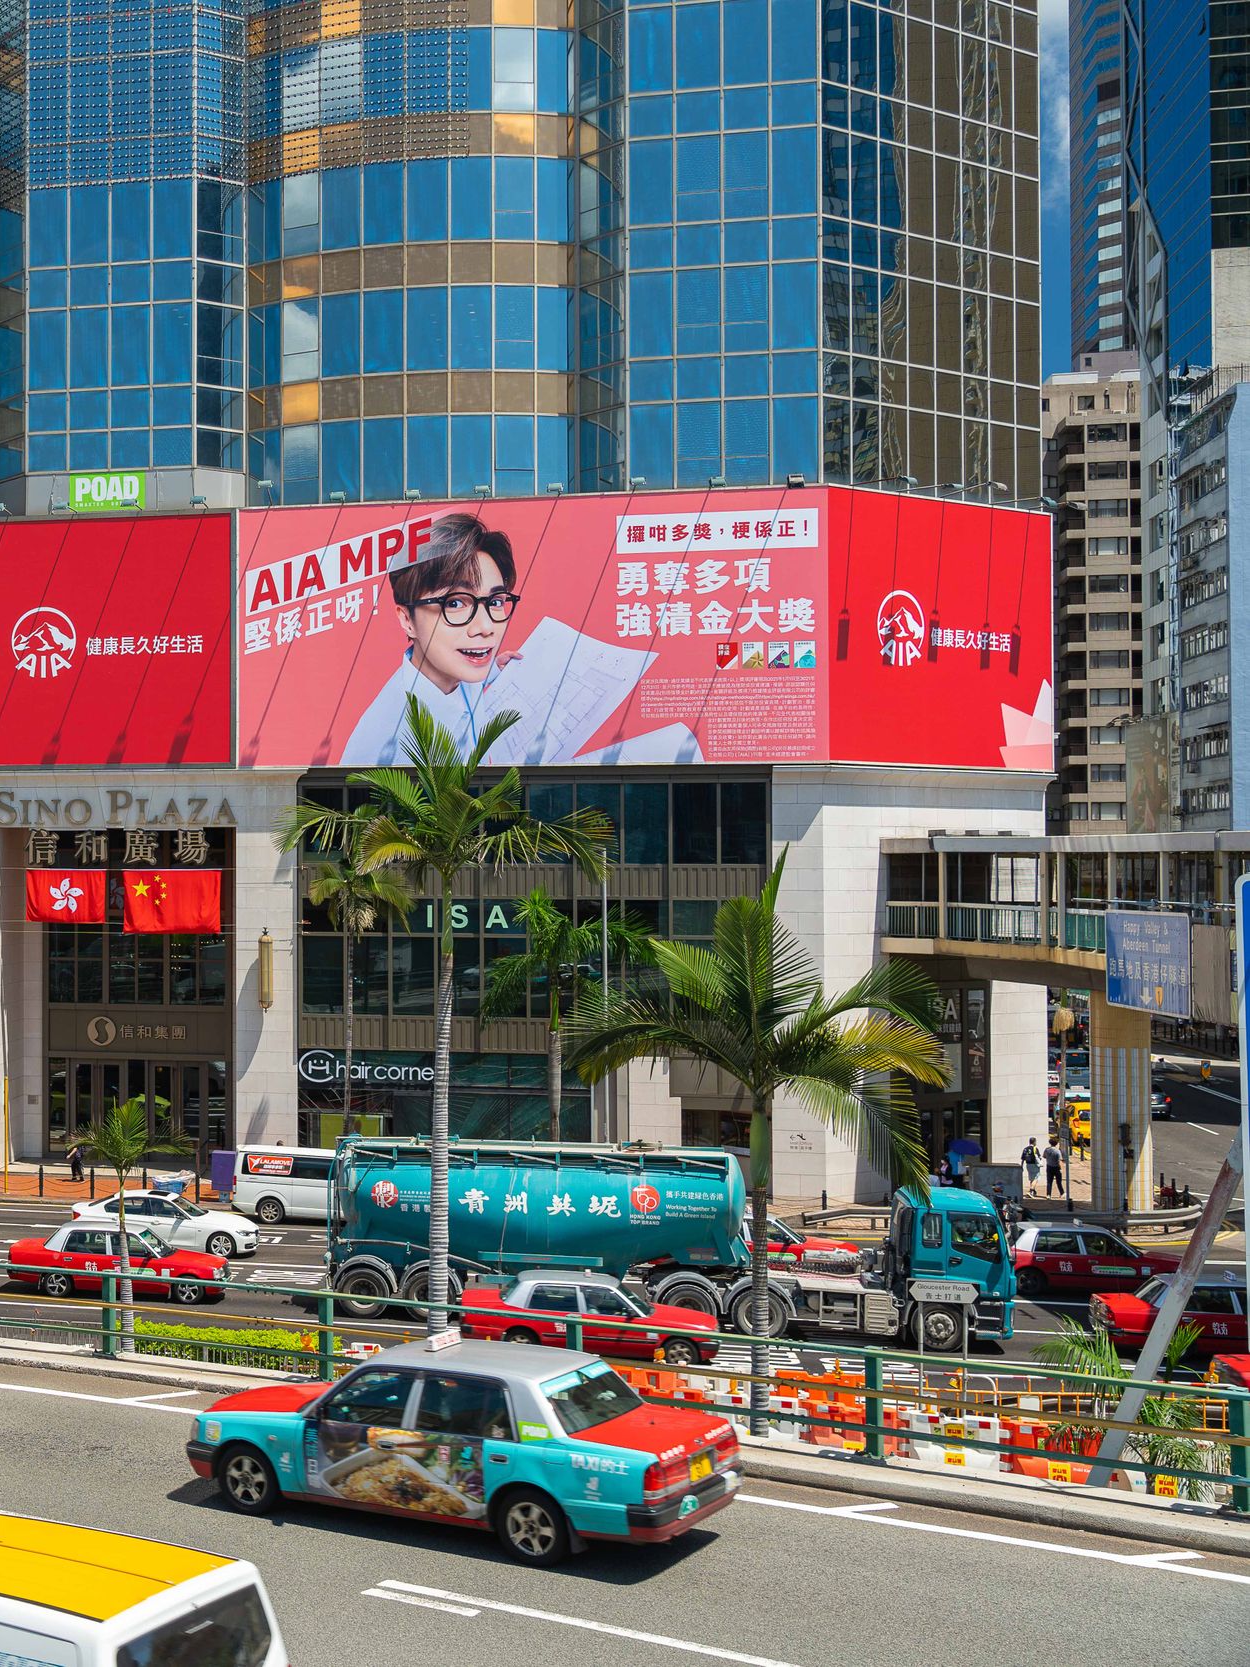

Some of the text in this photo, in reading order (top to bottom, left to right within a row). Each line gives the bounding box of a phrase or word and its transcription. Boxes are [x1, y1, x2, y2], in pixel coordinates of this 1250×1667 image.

[75, 475, 139, 502] POAD
[250, 517, 432, 613] AIA MPF
[616, 557, 772, 598] 勇奪多項
[616, 597, 816, 638] 強積金大獎
[86, 634, 204, 656] 健康長久好生活
[931, 626, 1012, 653] 健康長久好生活
[879, 638, 922, 667] AIA
[15, 653, 72, 679] AIA
[105, 789, 239, 826] PLAZA
[25, 828, 210, 866] 信和廣場
[1123, 921, 1169, 938] Happy Valley &
[1122, 938, 1171, 954] Aberdeen Tunnel
[120, 1024, 186, 1040] 信和集團
[336, 1060, 435, 1081] hair corne
[666, 1204, 687, 1212] Working
[687, 1205, 710, 1213] Together
[917, 1283, 951, 1291] Gloucester
[926, 1293, 961, 1301] 告士打道
[1213, 1327, 1228, 1335] TAXI
[569, 1453, 599, 1472] TAXI
